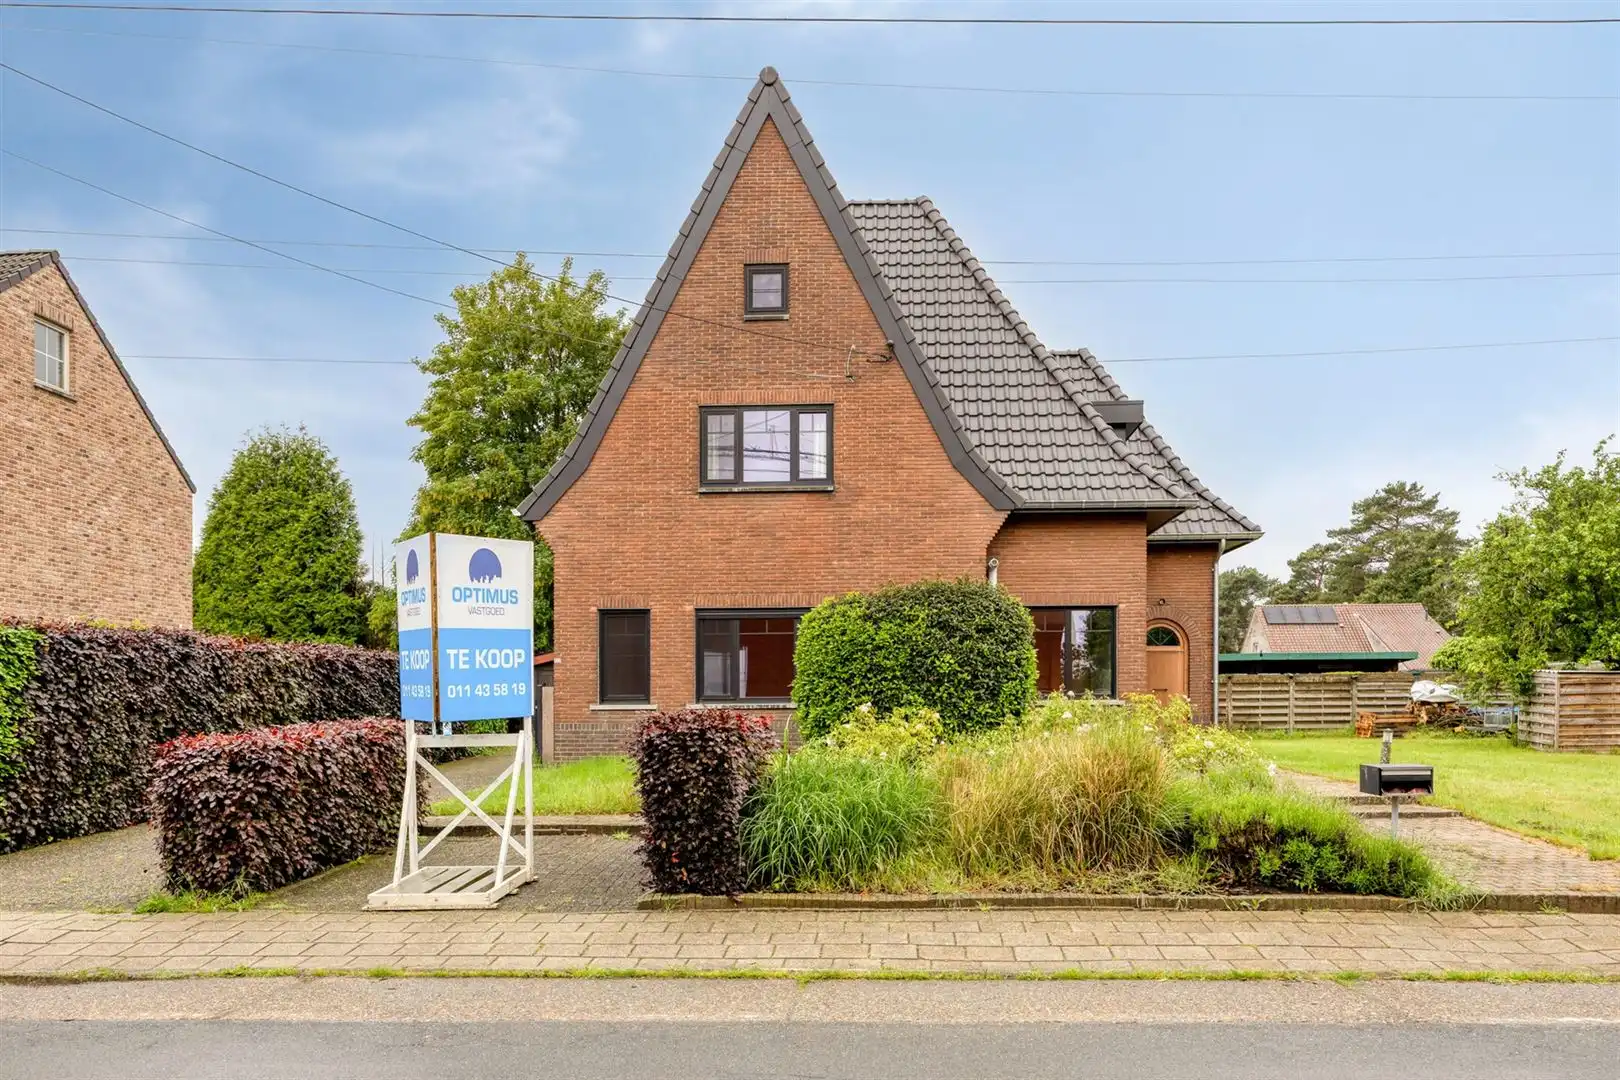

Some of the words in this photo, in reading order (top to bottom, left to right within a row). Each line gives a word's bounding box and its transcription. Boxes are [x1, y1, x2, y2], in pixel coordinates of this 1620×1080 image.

[452, 587, 518, 604] OPTIMUS
[468, 606, 504, 616] VASTGOED
[410, 649, 430, 670] KOOP
[447, 649, 470, 669] TE
[476, 649, 526, 668] KOOP
[448, 684, 470, 698] 011
[475, 684, 490, 698] 43
[494, 683, 508, 696] 58
[512, 682, 526, 696] 19
